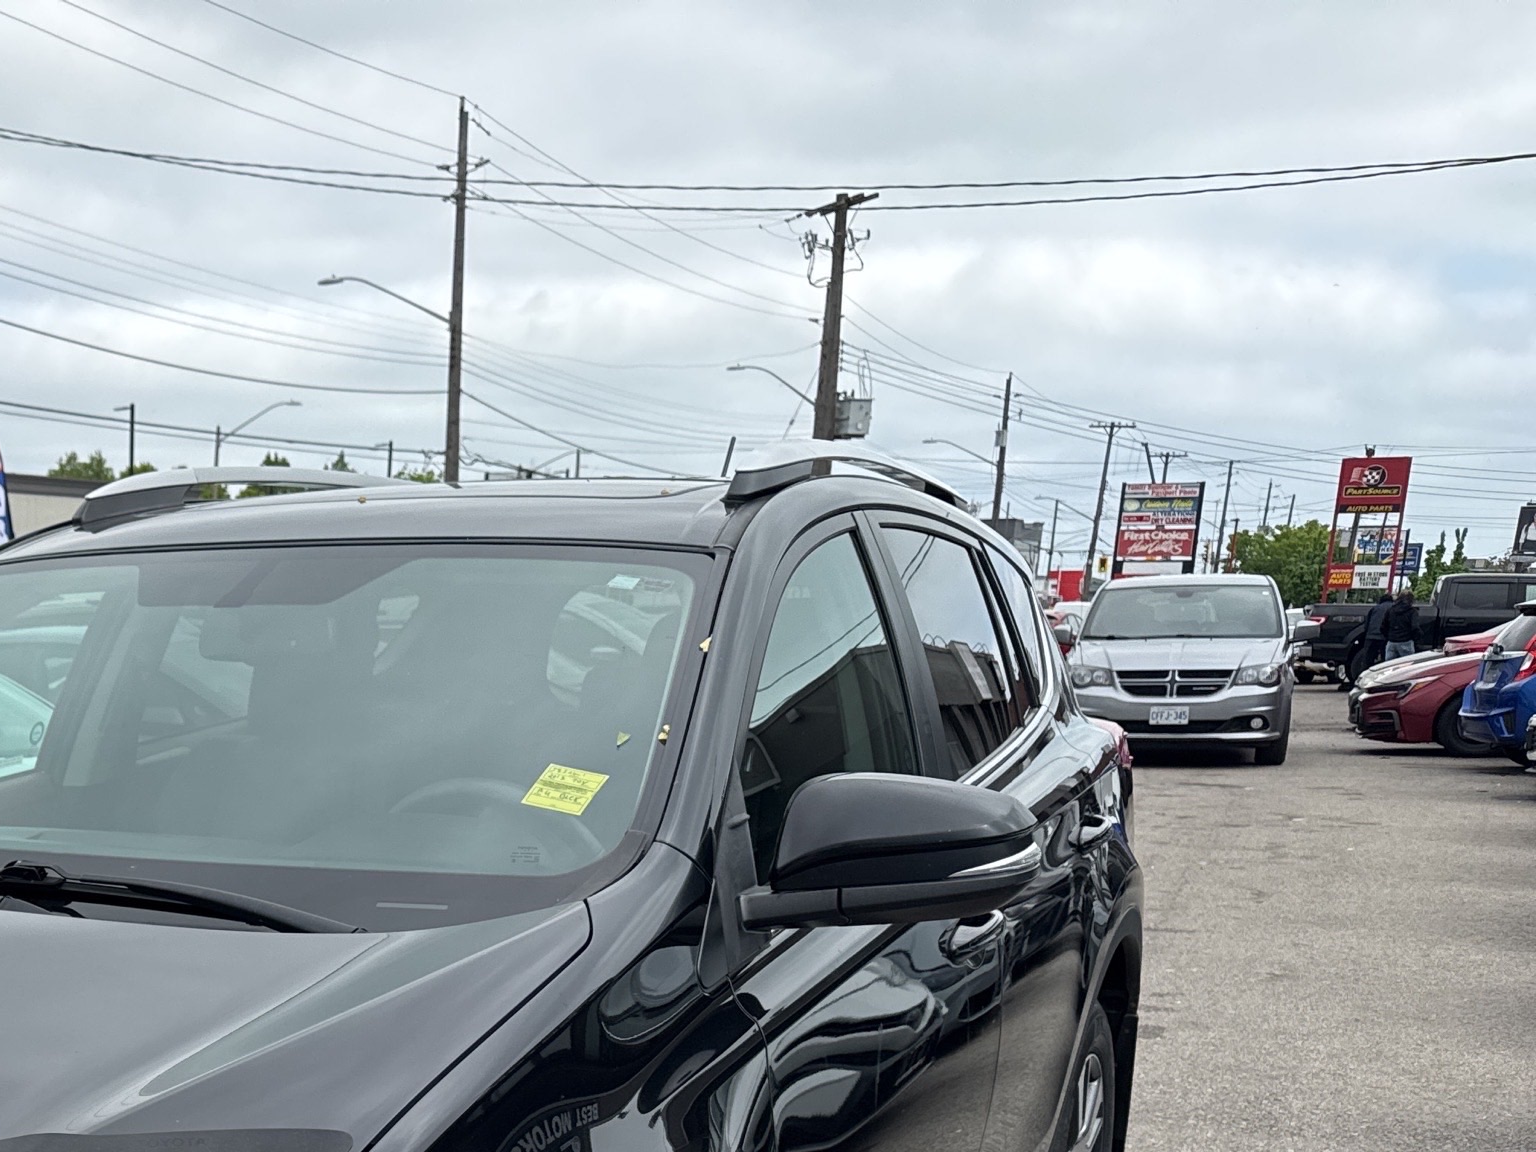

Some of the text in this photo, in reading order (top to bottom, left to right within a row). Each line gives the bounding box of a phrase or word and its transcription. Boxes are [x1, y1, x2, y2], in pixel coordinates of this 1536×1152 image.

[1124, 530, 1190, 540] First Choice
[575, 1103, 599, 1127] BEST
